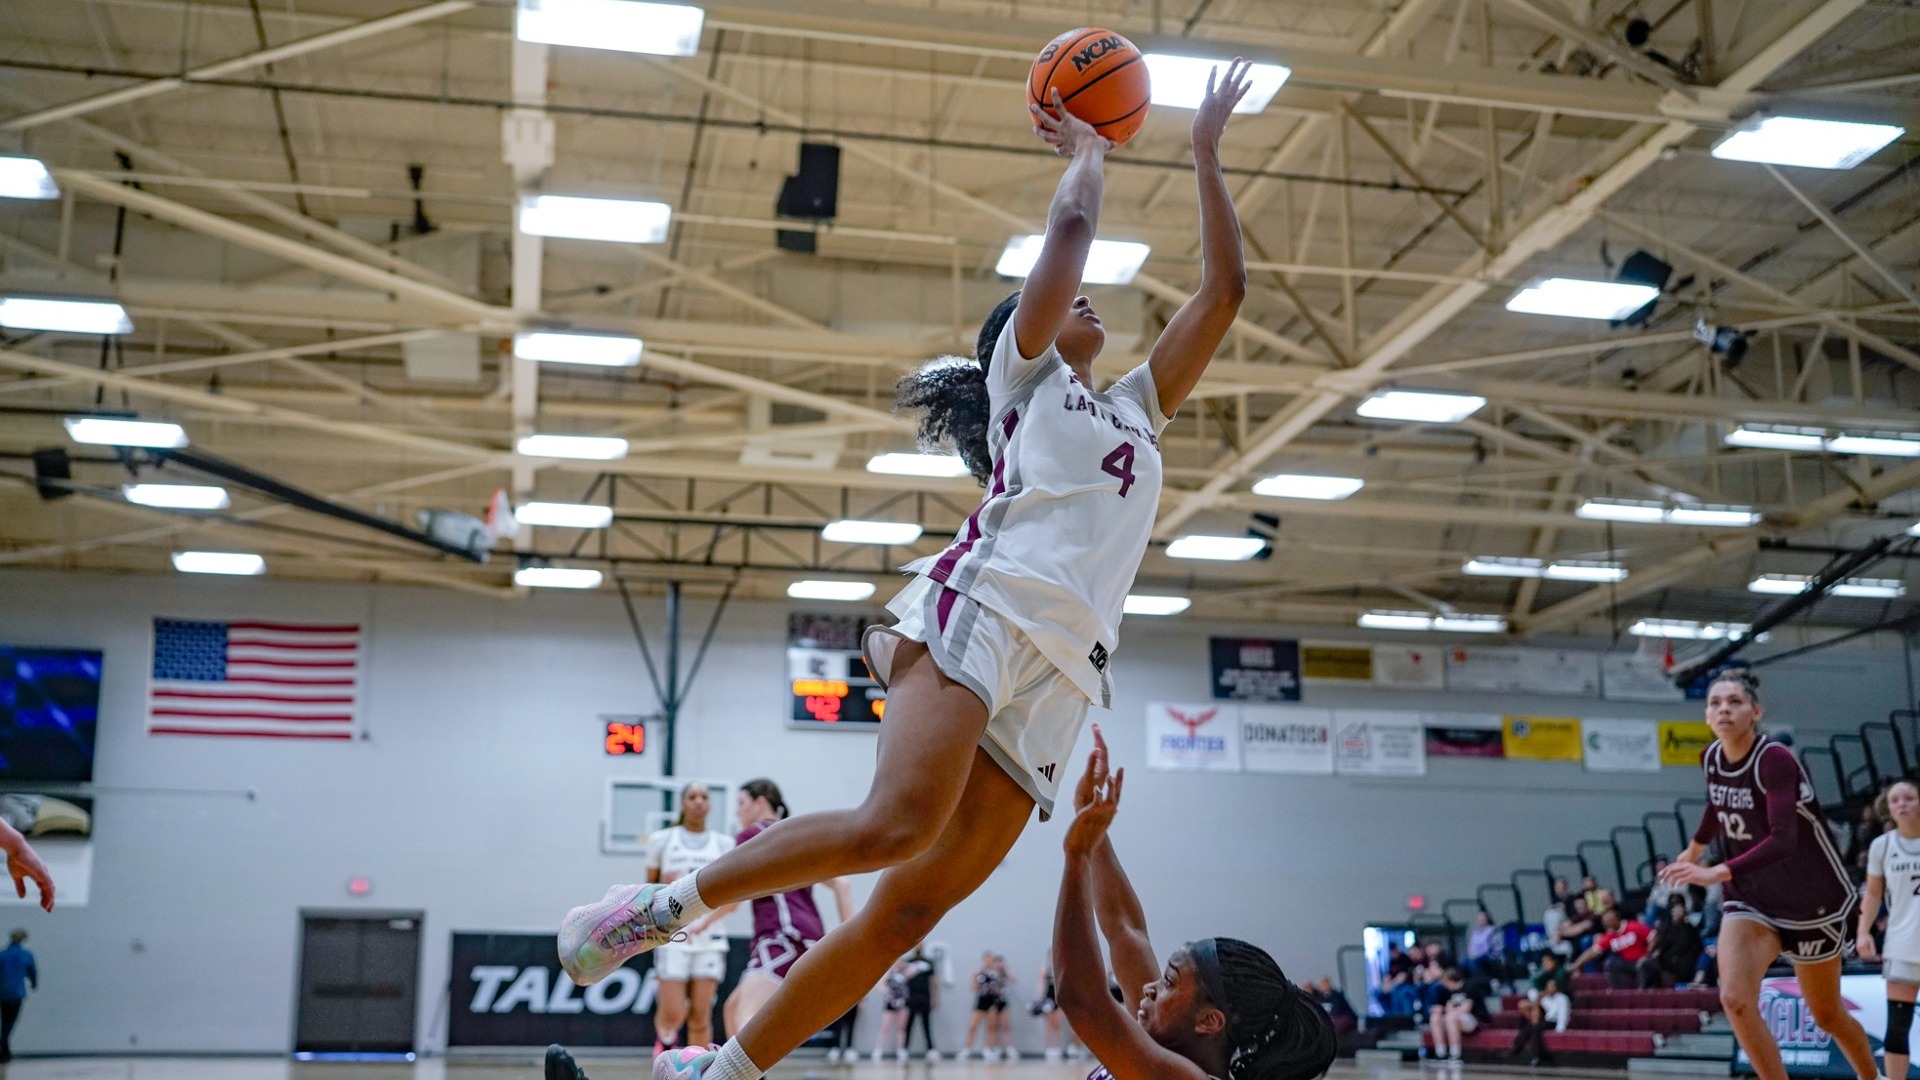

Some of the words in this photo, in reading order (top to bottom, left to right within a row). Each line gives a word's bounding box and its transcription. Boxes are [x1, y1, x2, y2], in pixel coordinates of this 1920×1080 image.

[1070, 35, 1126, 73] NCAA
[1101, 441, 1136, 498] 4
[606, 722, 645, 755] 24
[1717, 810, 1753, 841] 22
[1797, 938, 1827, 958] WT
